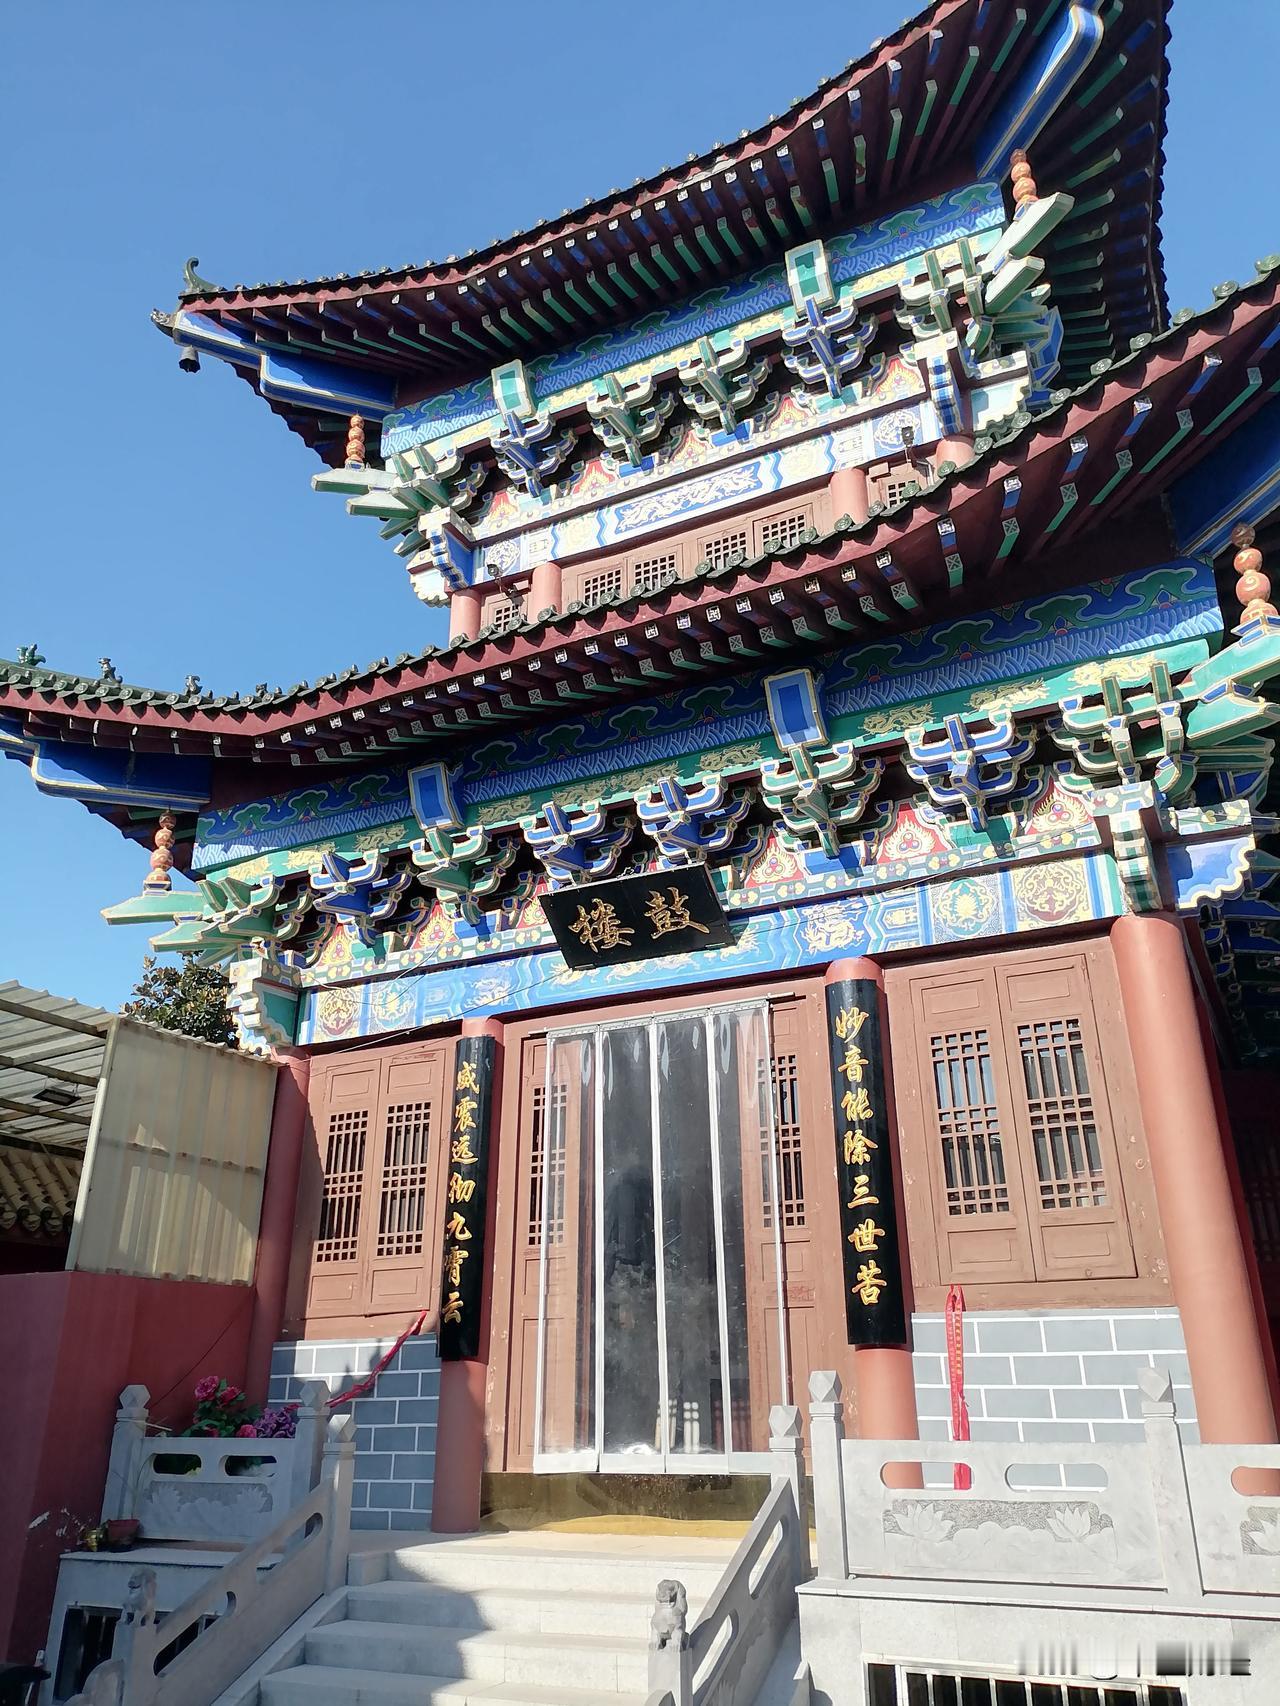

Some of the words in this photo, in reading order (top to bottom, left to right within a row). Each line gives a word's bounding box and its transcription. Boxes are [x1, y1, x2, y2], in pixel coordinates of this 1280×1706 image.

[835, 1007, 886, 1306] 妙音能除三世苦
